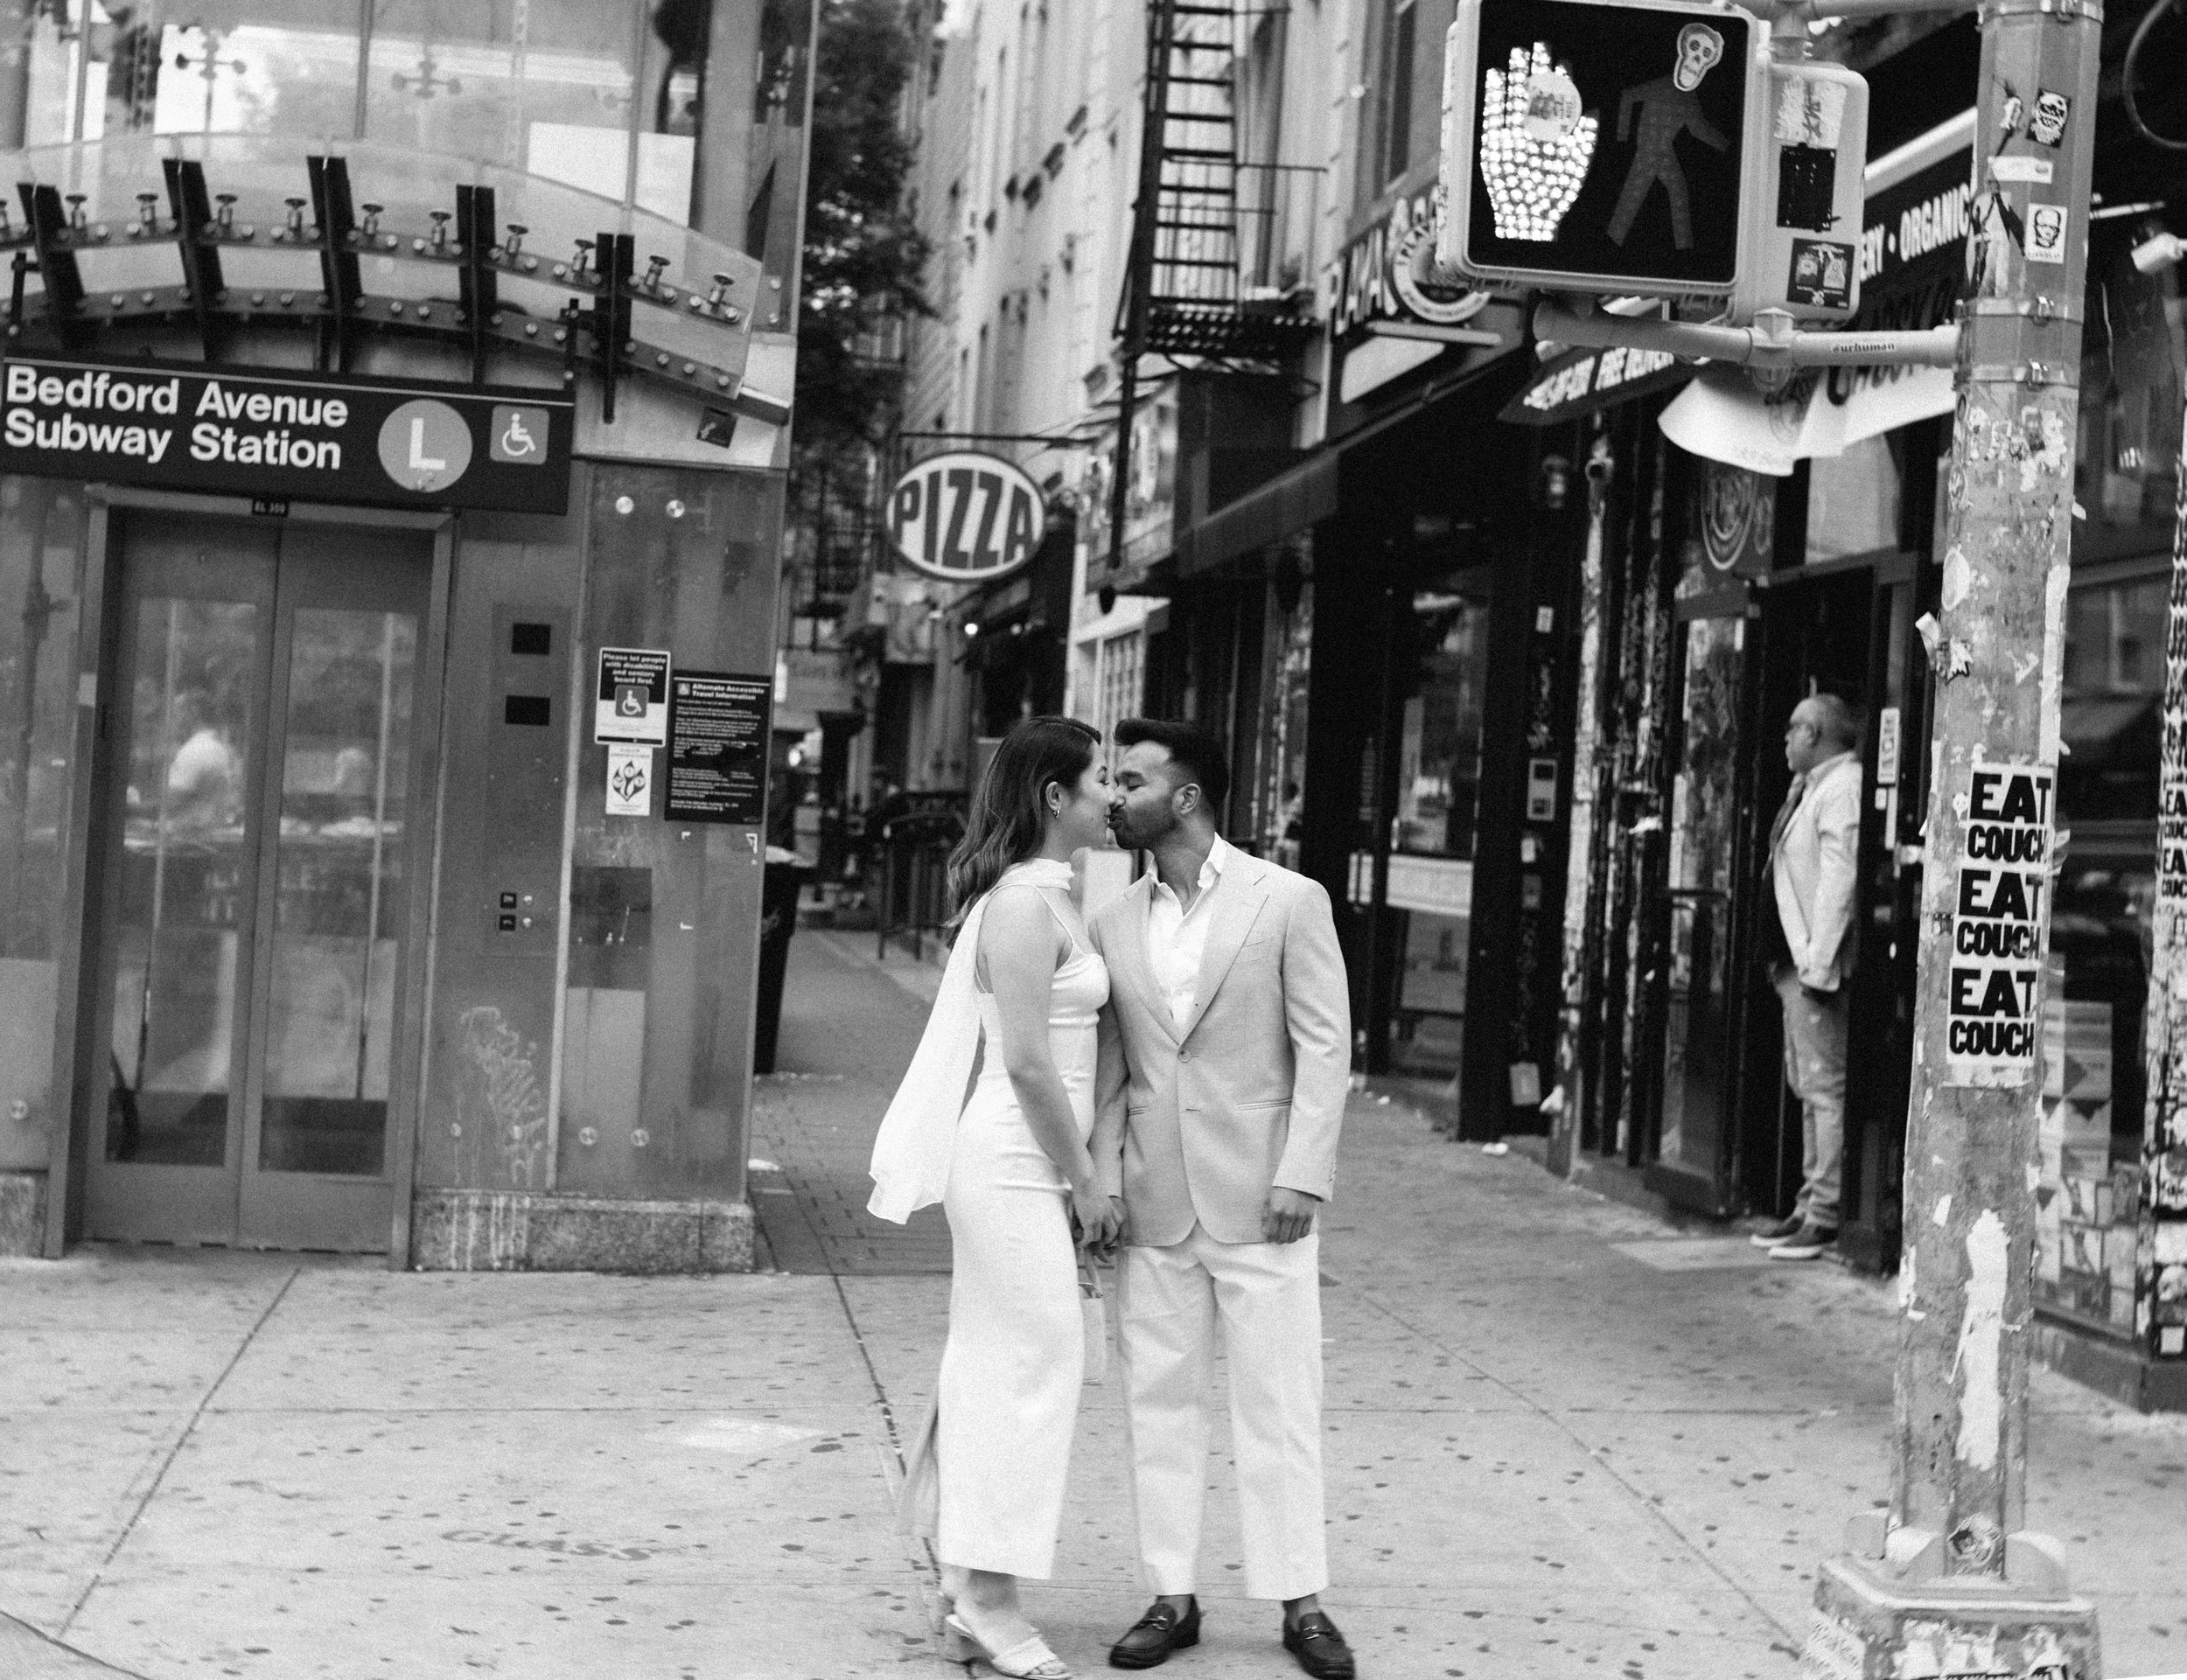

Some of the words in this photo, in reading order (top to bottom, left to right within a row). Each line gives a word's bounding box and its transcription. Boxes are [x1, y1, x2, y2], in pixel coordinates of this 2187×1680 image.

[6, 364, 180, 415] Bedford
[195, 380, 348, 428] Avenue
[4, 407, 172, 464] Subway
[189, 422, 341, 471] Station
[409, 417, 446, 471] L
[893, 469, 1032, 568] PIZZA
[603, 652, 628, 661] Please
[623, 662, 663, 671] disabilities
[692, 683, 725, 692] Alternate
[726, 685, 765, 694] Accessible
[715, 692, 756, 701] Information
[1969, 771, 2052, 826] EAT
[2165, 790, 2187, 816] EA
[1967, 825, 2048, 864] COUCH
[2163, 820, 2187, 840] COUC
[2163, 848, 2187, 875] EA
[1959, 868, 2044, 922] EAT
[2161, 878, 2187, 899] COUC
[1956, 921, 2040, 961] COUCH
[1950, 967, 2037, 1018] EAT
[1949, 1020, 2035, 1058] COUCH
